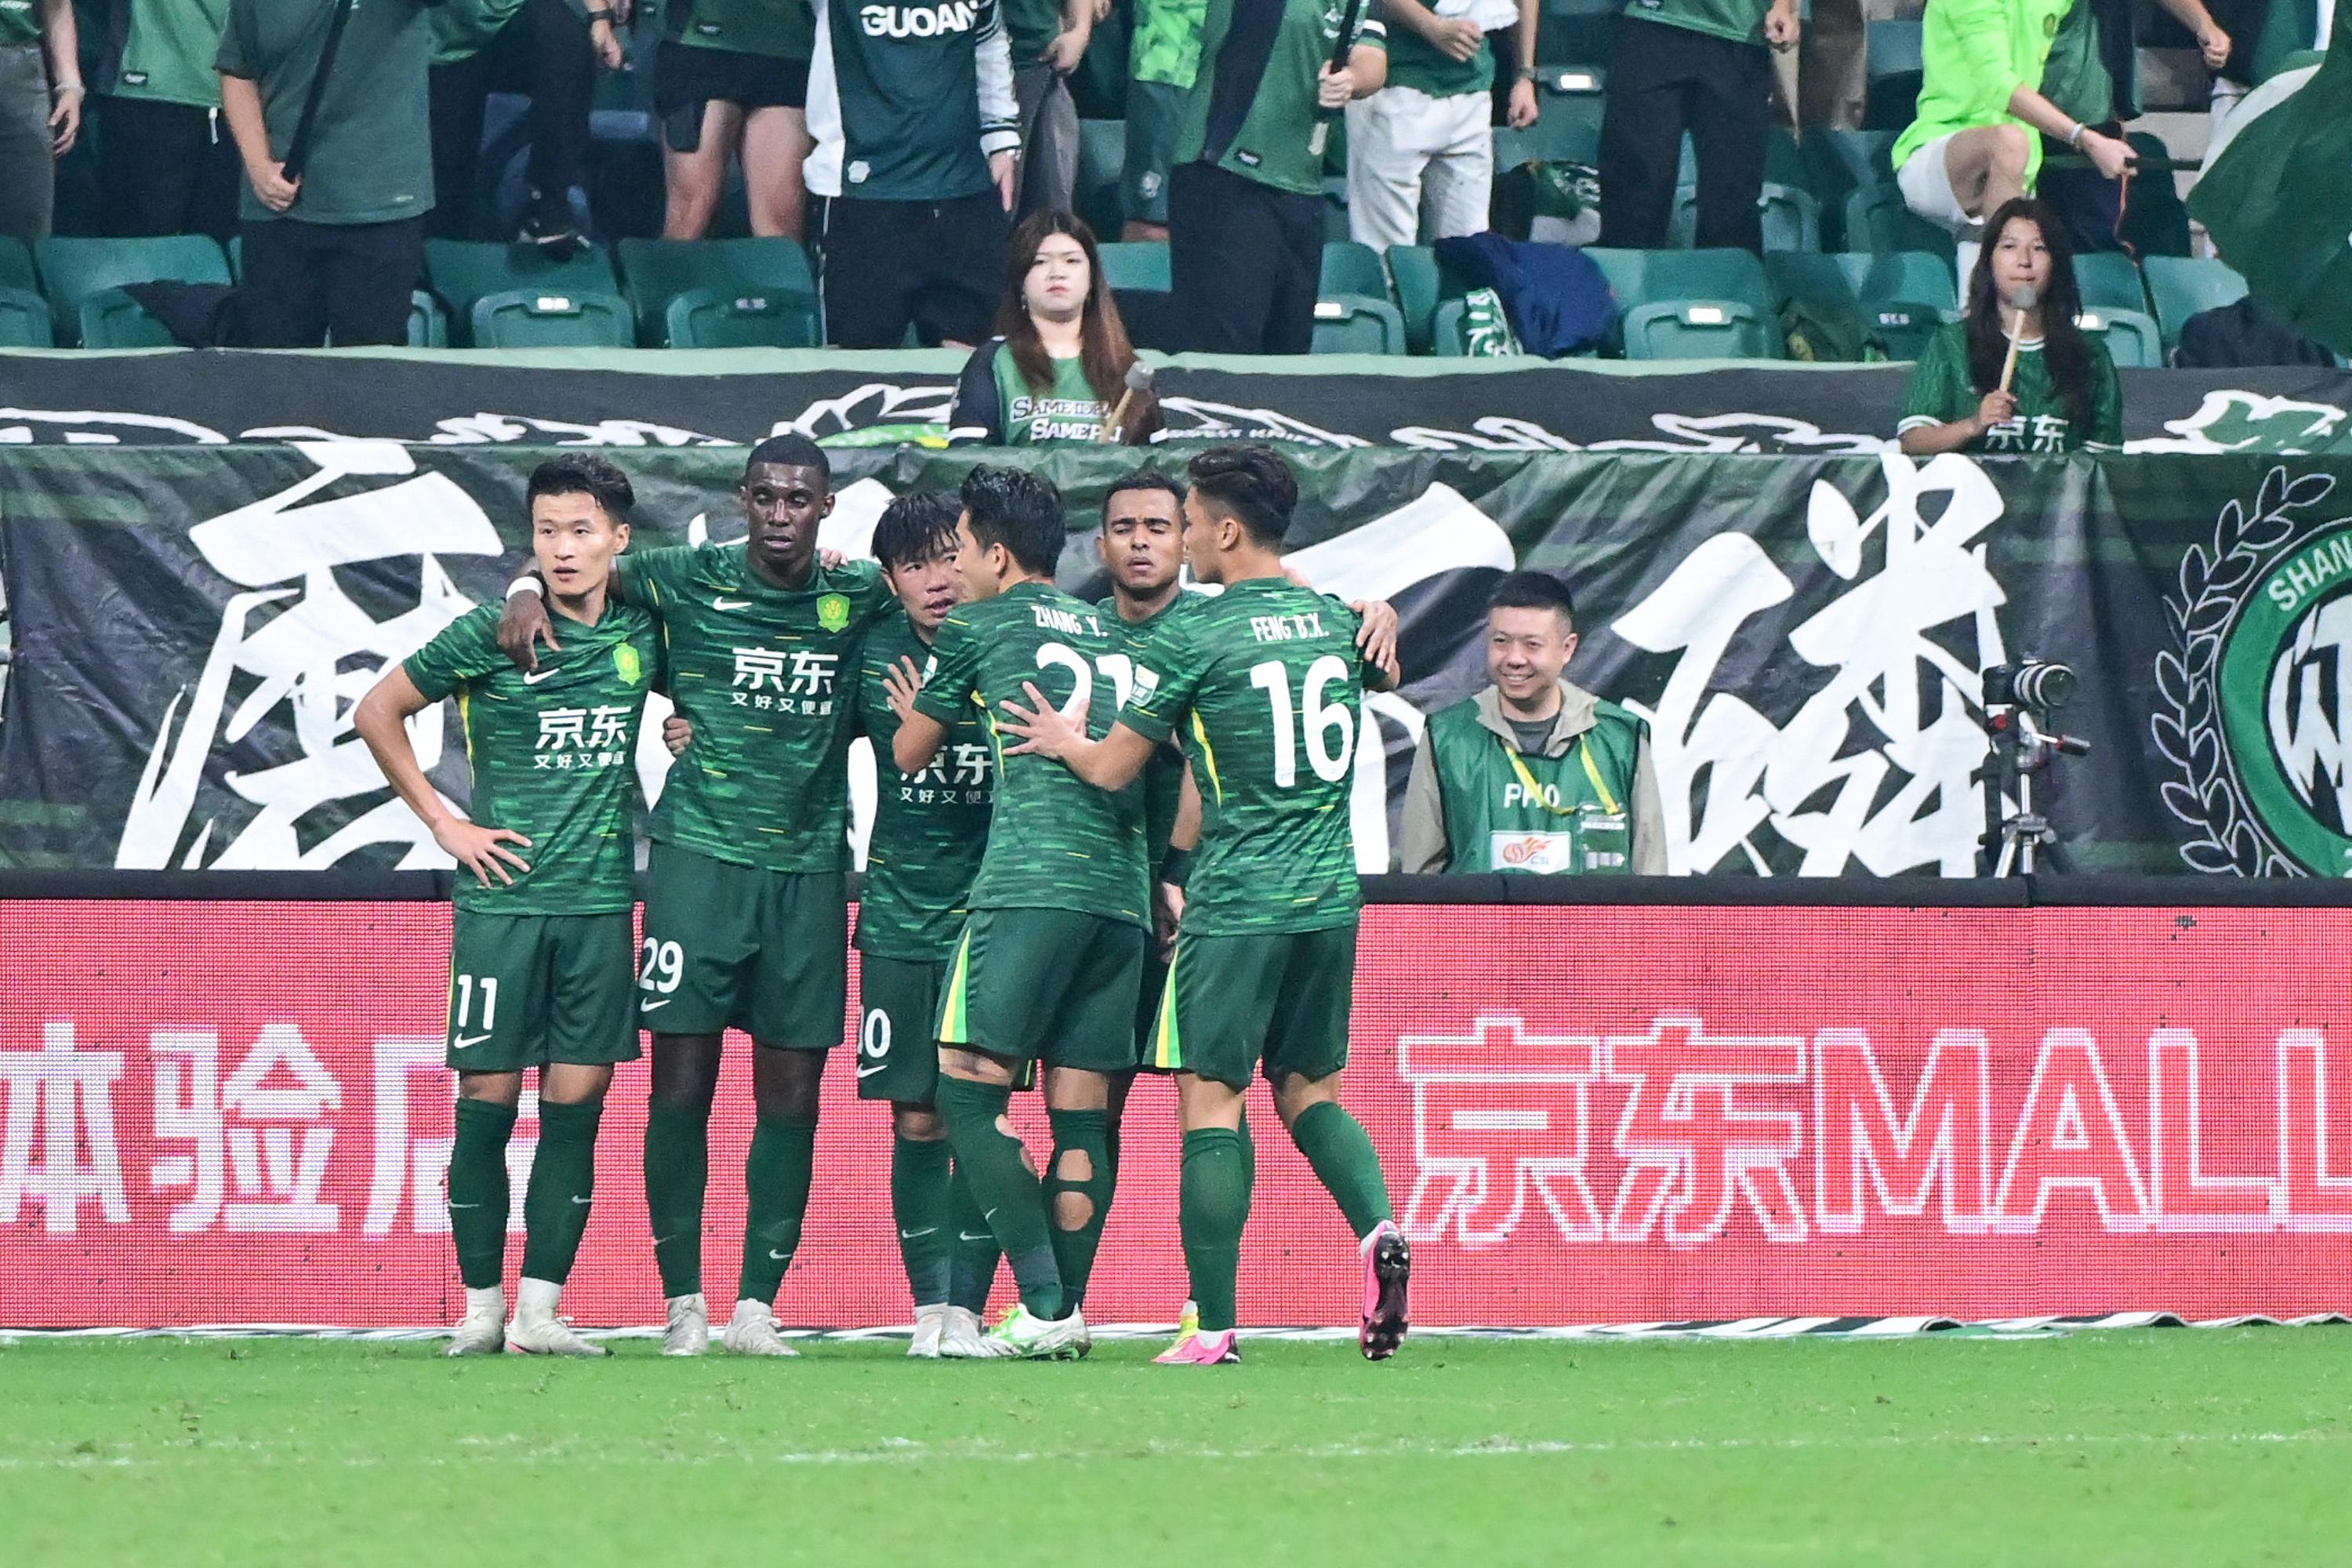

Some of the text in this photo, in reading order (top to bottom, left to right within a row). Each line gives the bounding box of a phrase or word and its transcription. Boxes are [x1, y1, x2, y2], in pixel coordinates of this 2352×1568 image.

[859, 1, 978, 38] GUOAN
[1984, 414, 2069, 454] 京东
[2268, 535, 2352, 612] SHAN
[1031, 605, 1109, 637] ZHANG Y.
[1250, 612, 1330, 641] FENG B.X.
[731, 647, 839, 696] 京东
[535, 705, 632, 750] 京东
[1250, 655, 1354, 788] 16
[900, 786, 993, 804] 又好又便
[639, 937, 684, 993] 29
[458, 975, 498, 1030] 11
